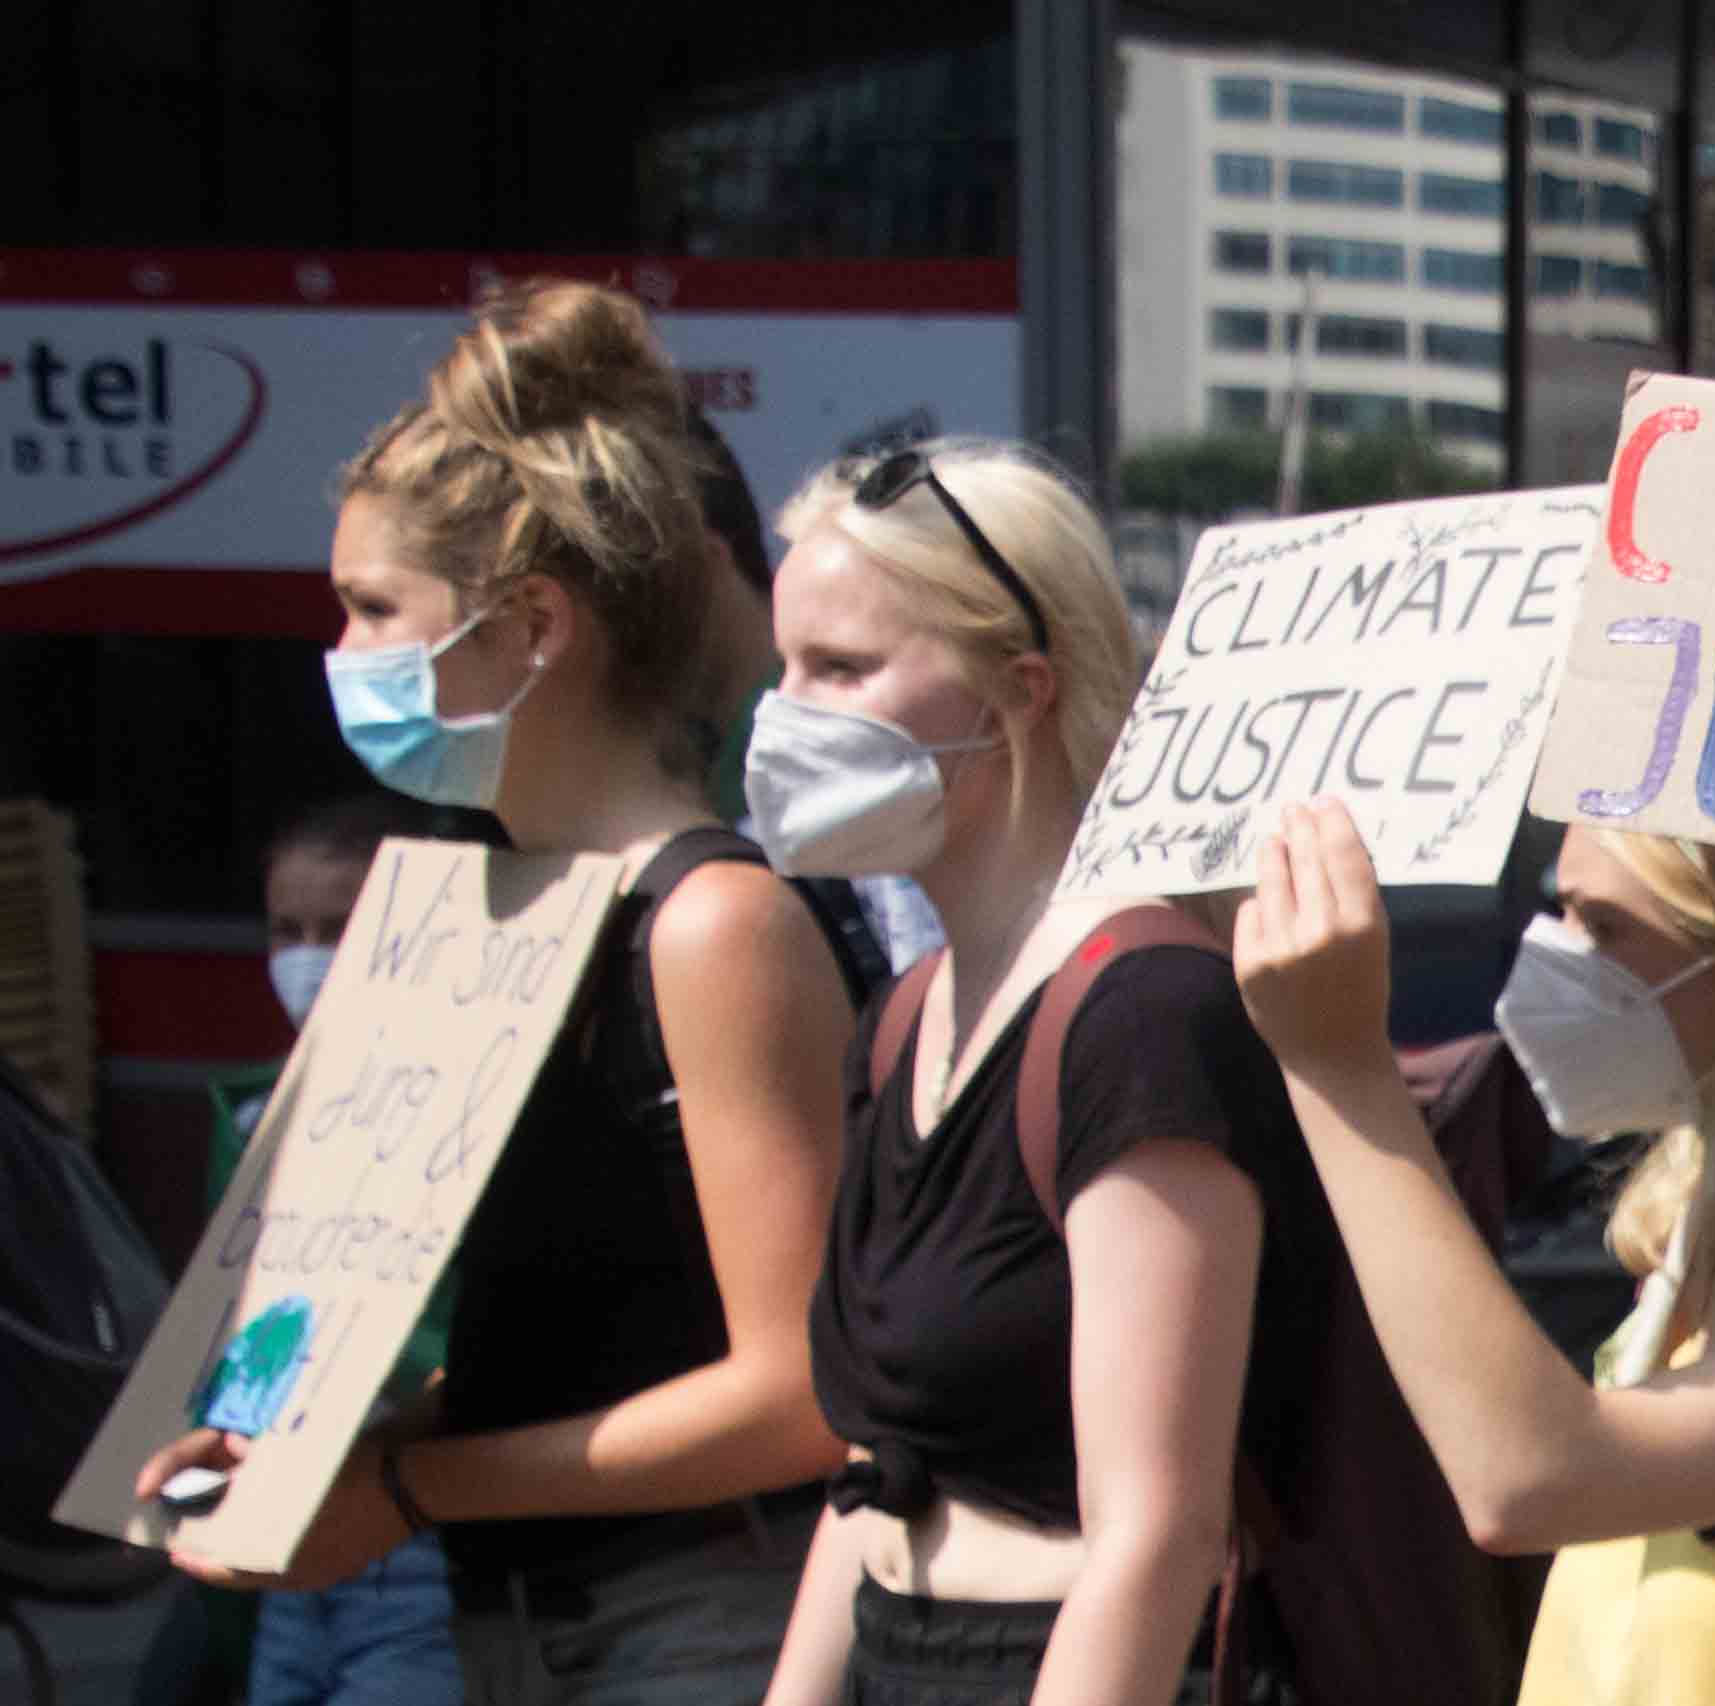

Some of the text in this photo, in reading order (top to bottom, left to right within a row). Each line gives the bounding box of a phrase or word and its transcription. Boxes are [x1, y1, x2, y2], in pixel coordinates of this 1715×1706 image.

[0, 337, 173, 427] tel
[1184, 543, 1583, 657] CLIMATE
[1110, 681, 1488, 809] JUSTICE
